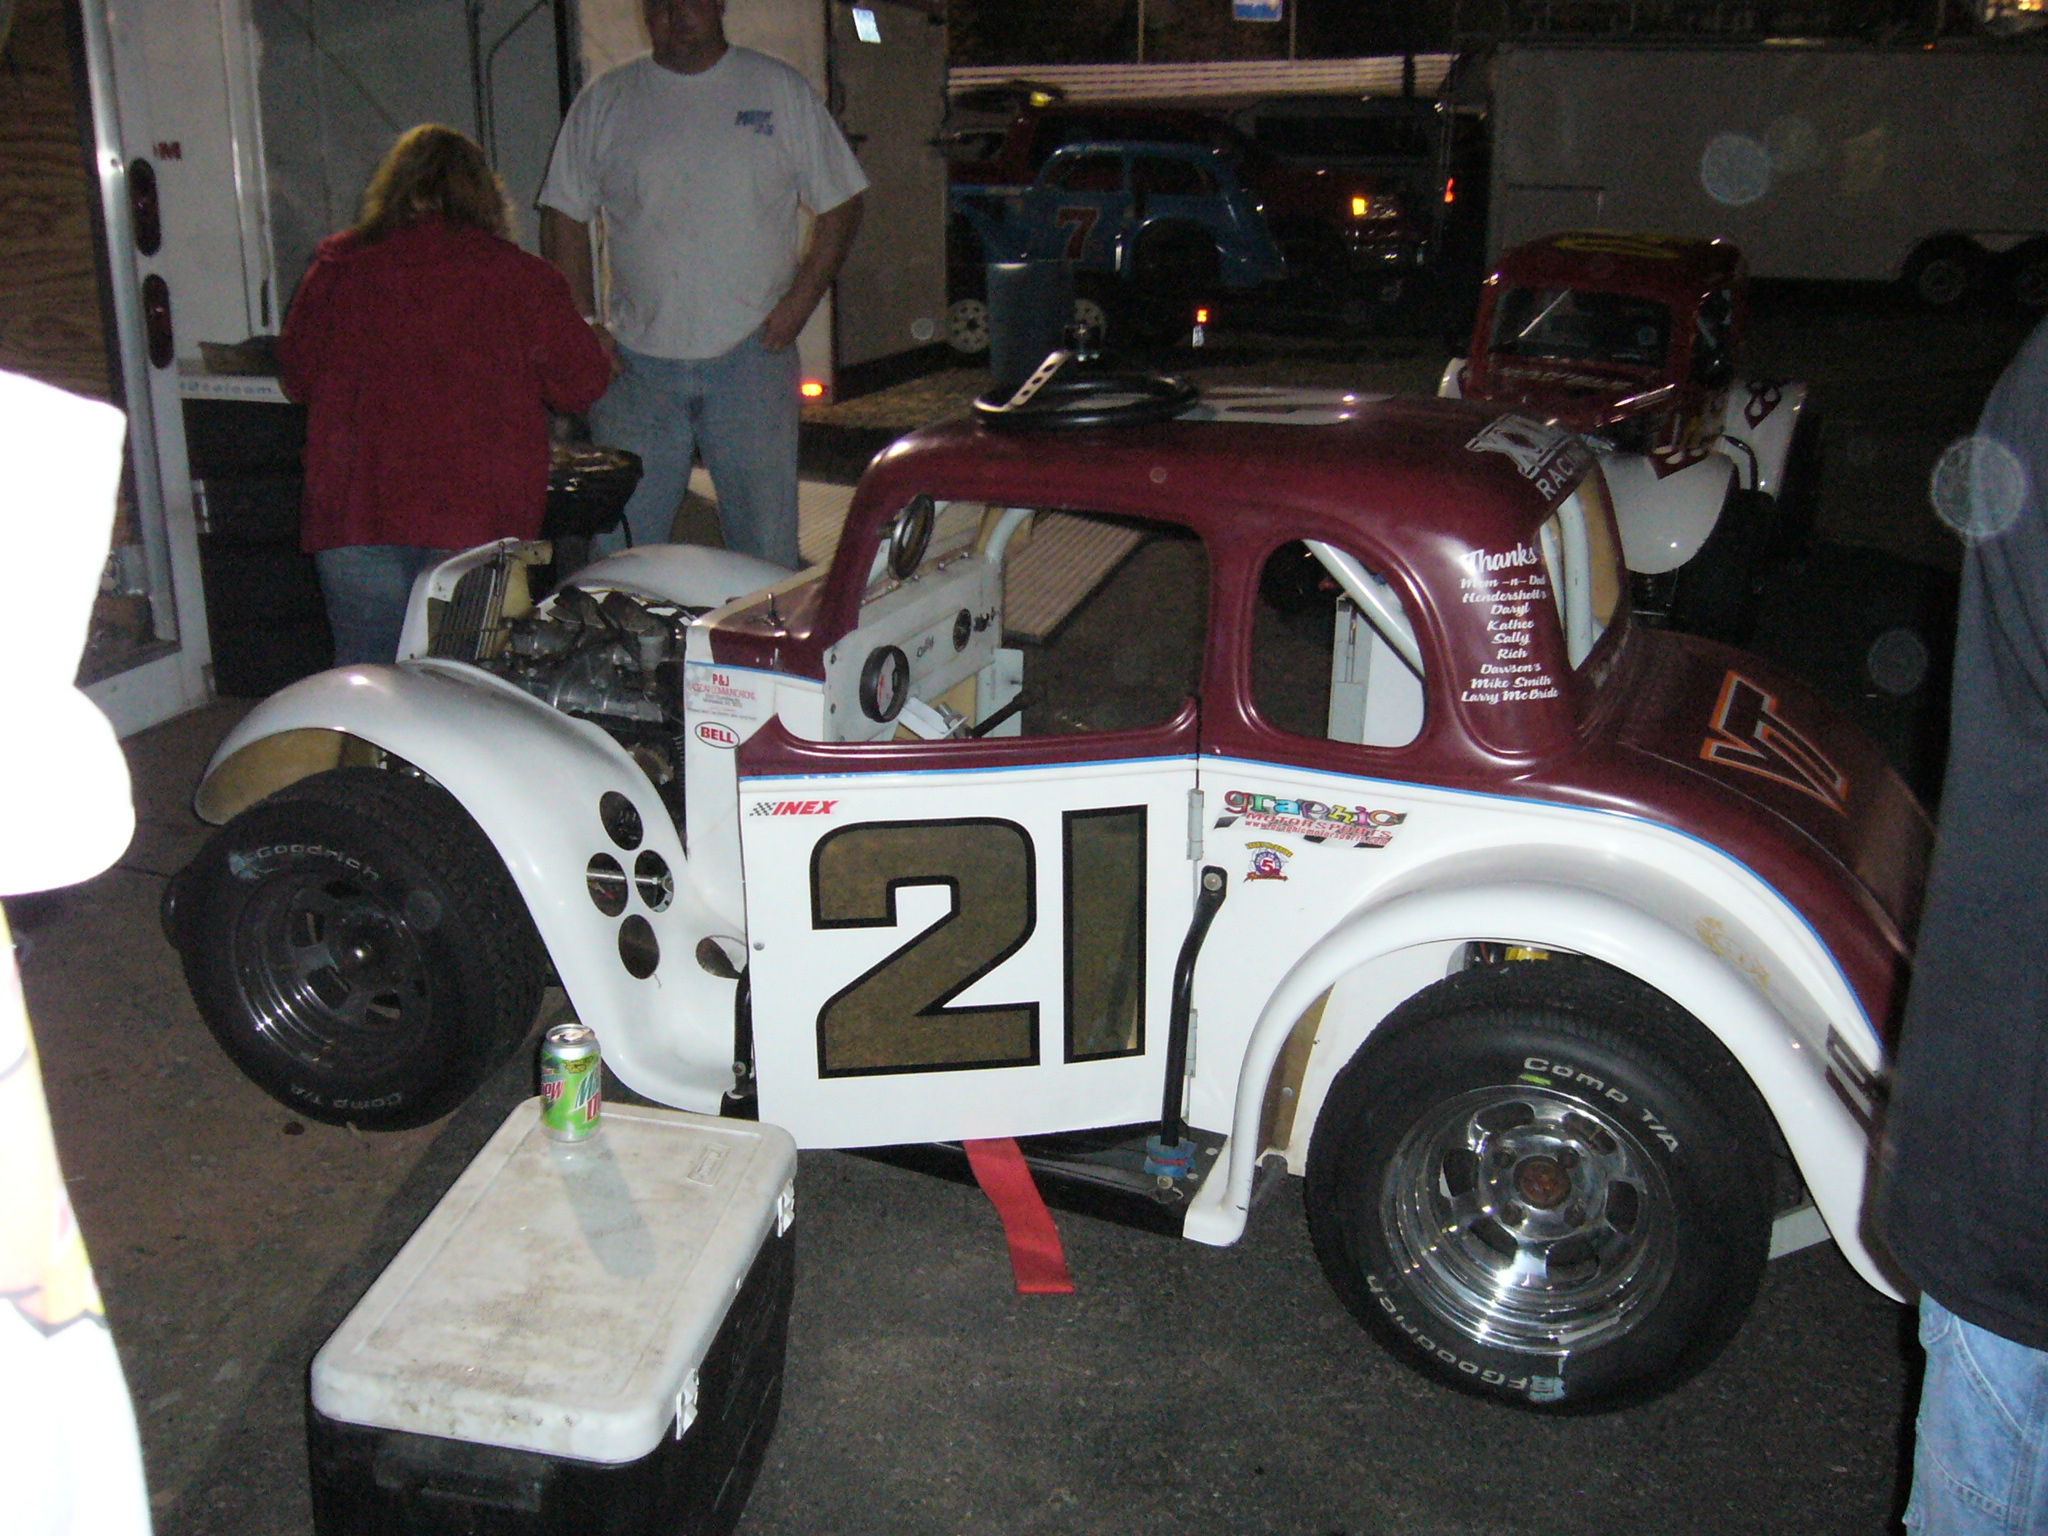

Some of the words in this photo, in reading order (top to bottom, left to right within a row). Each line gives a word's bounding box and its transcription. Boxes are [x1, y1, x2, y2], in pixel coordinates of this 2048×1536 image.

[1055, 206, 1099, 261] 7
[1460, 542, 1538, 574] Thanks
[1490, 601, 1531, 617] Daryl
[1491, 631, 1531, 646] Sally
[1496, 647, 1529, 660] Rich
[1470, 677, 1510, 690] Mike
[1512, 674, 1553, 688] Smith
[1461, 689, 1500, 706] Larry
[700, 726, 735, 745] BELL
[771, 799, 840, 816] INEX
[1245, 812, 1393, 839] MOTORSPORTS
[1261, 858, 1275, 874] 5
[809, 803, 1148, 1079] 21
[1523, 1056, 1629, 1104] Comp
[1641, 1107, 1679, 1153] T/A
